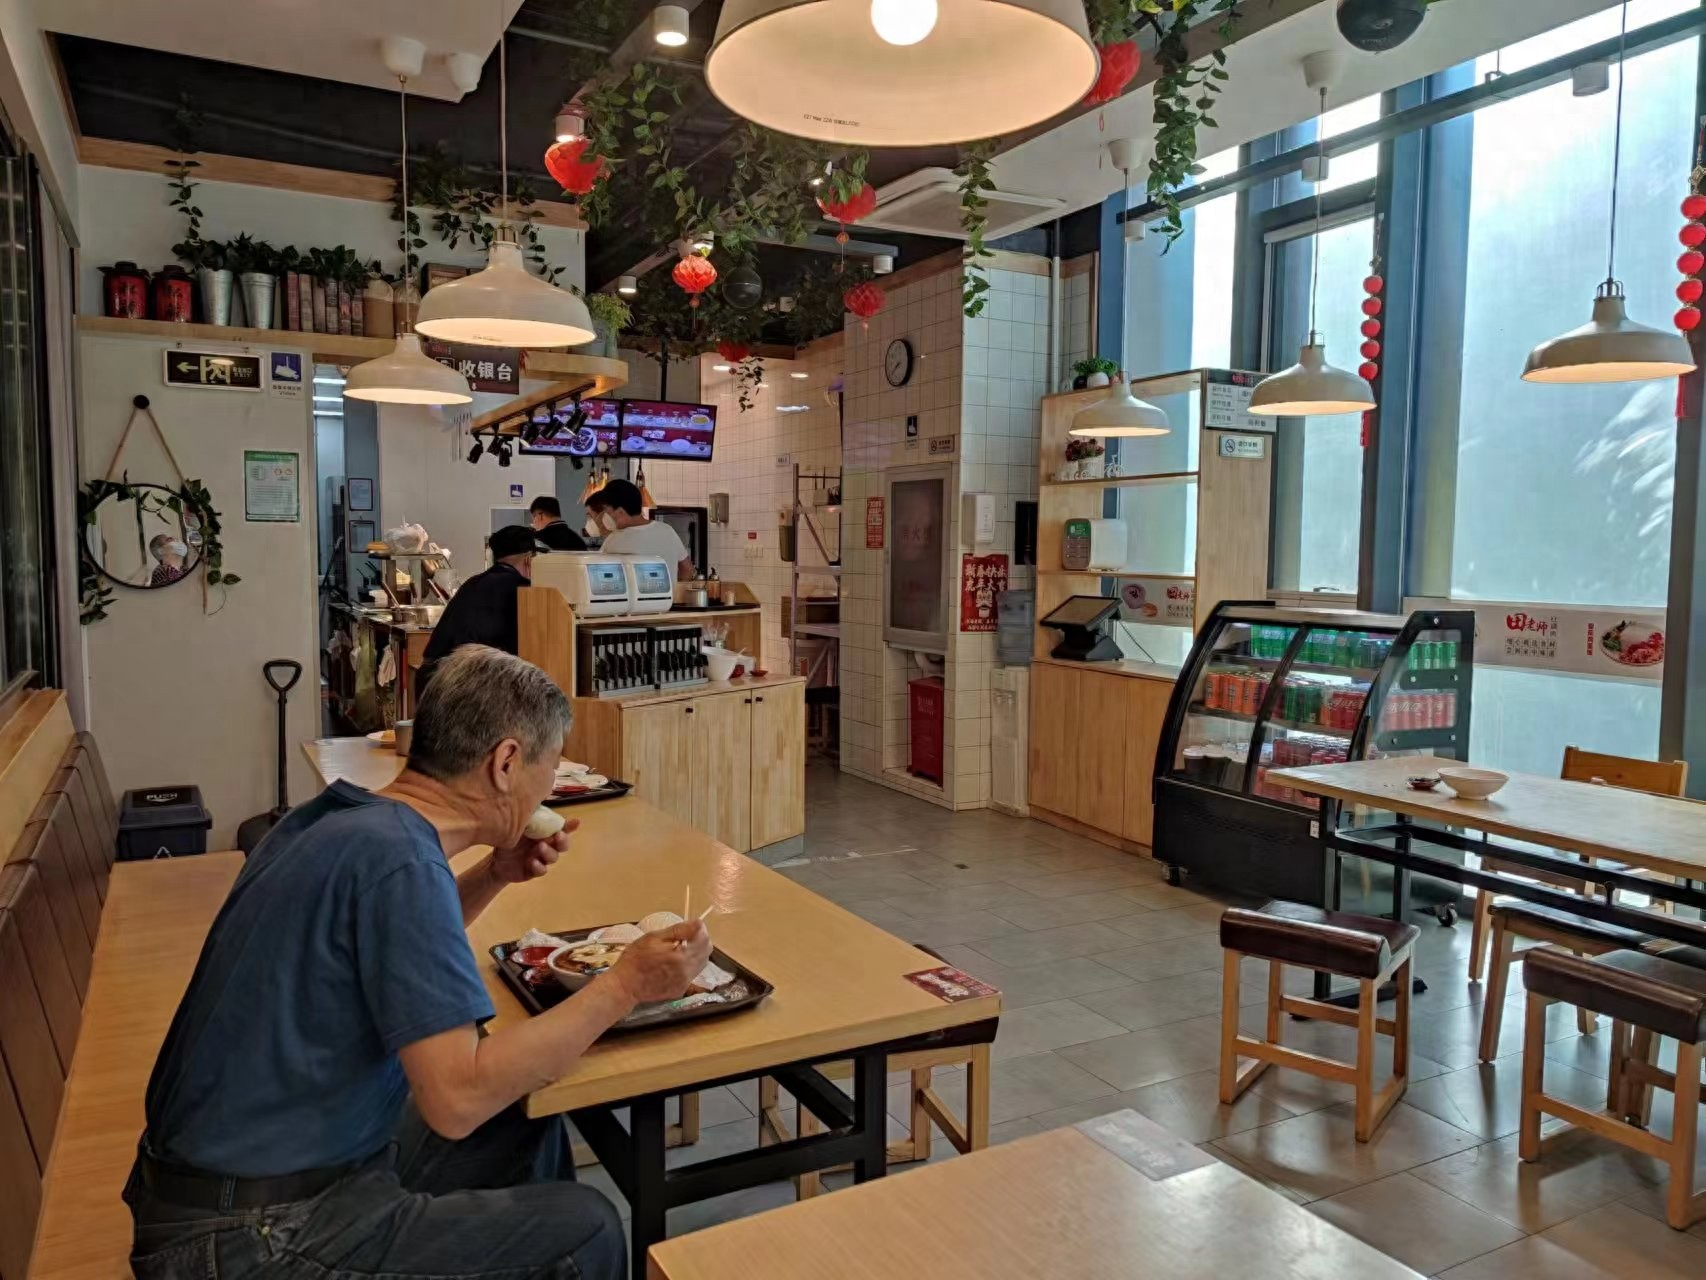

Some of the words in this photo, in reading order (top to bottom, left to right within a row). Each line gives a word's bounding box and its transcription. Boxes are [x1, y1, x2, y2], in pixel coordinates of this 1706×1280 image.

[459, 360, 513, 382] 收银台
[965, 564, 1007, 578] 新春快乐
[1506, 613, 1549, 636] 田老师
[146, 792, 178, 801] PUSH
